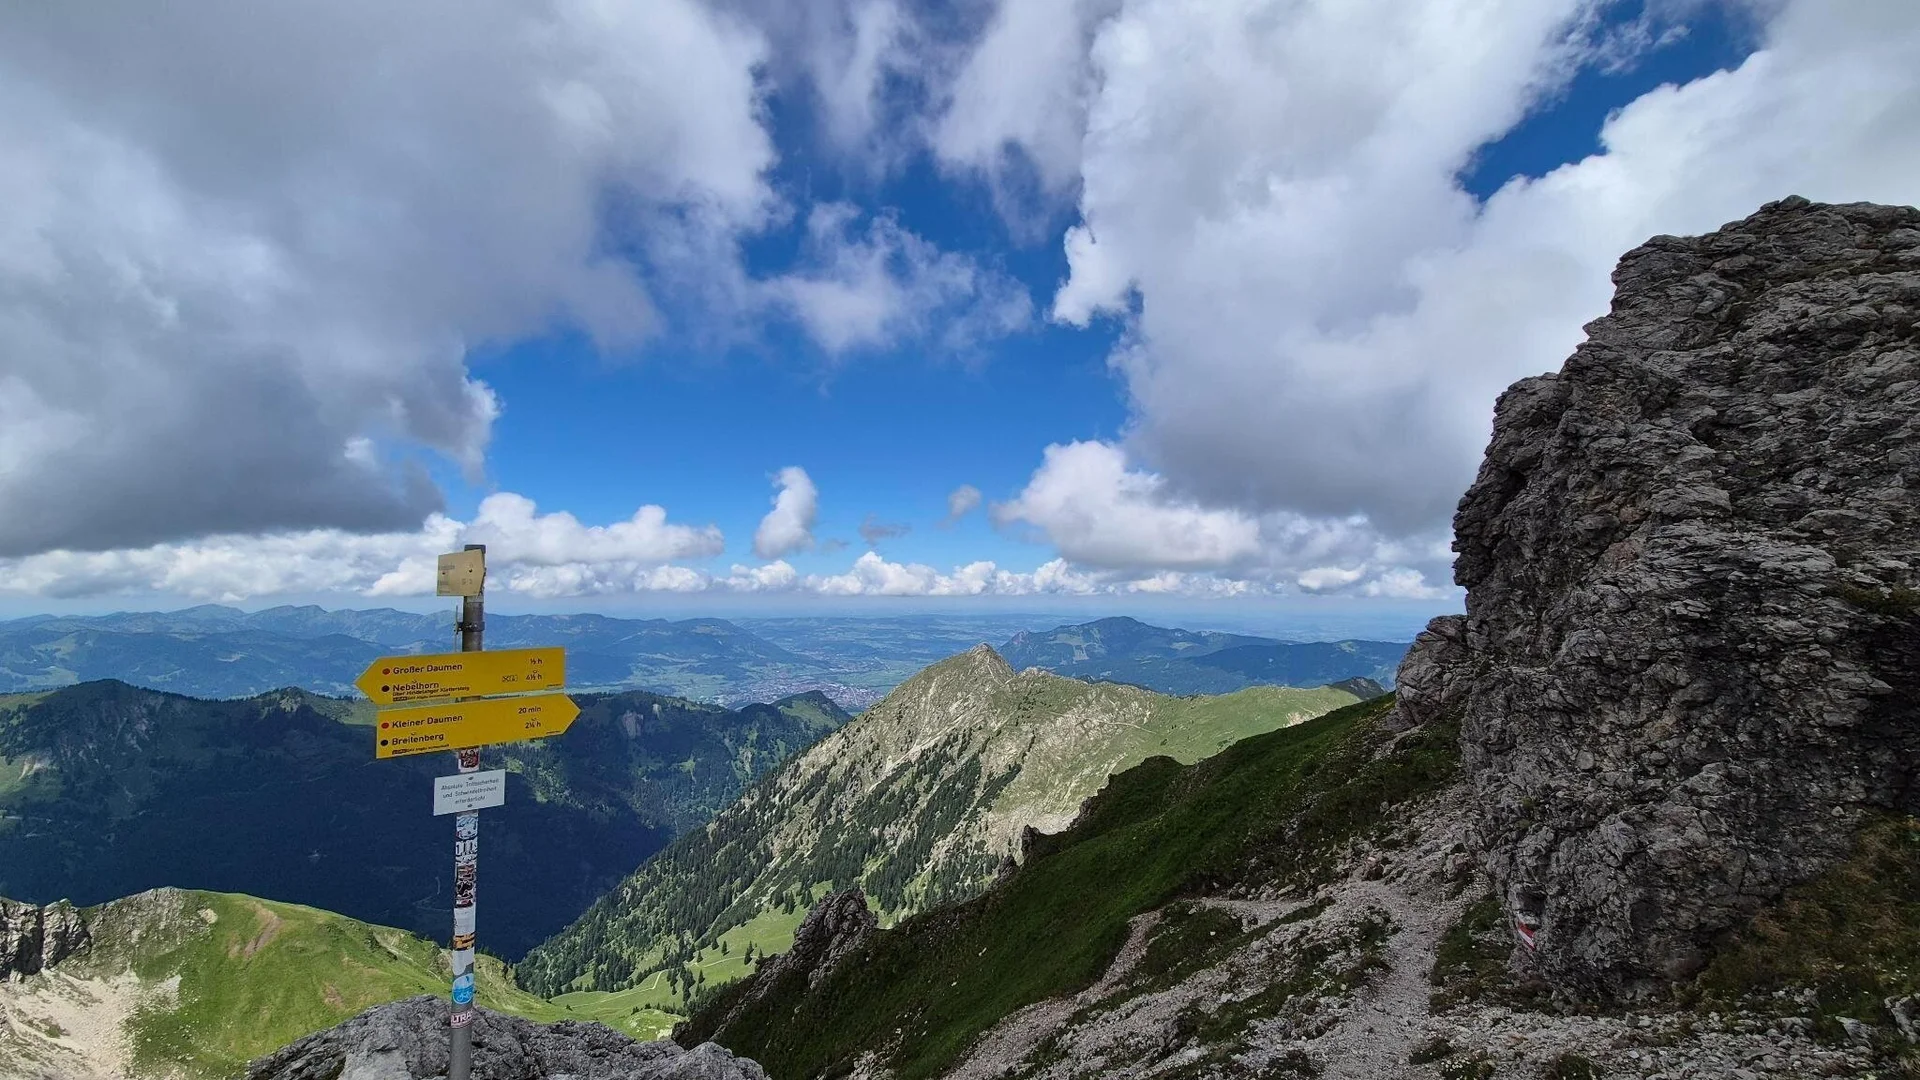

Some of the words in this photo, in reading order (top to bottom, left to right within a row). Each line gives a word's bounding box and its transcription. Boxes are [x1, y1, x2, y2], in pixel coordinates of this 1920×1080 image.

[393, 665, 425, 675] Großer
[427, 664, 463, 673] Daumen
[393, 682, 440, 692] Nebelhorn
[392, 719, 425, 729] Kleiner
[427, 715, 463, 725] Daumen
[392, 734, 444, 746] Breitenberg
